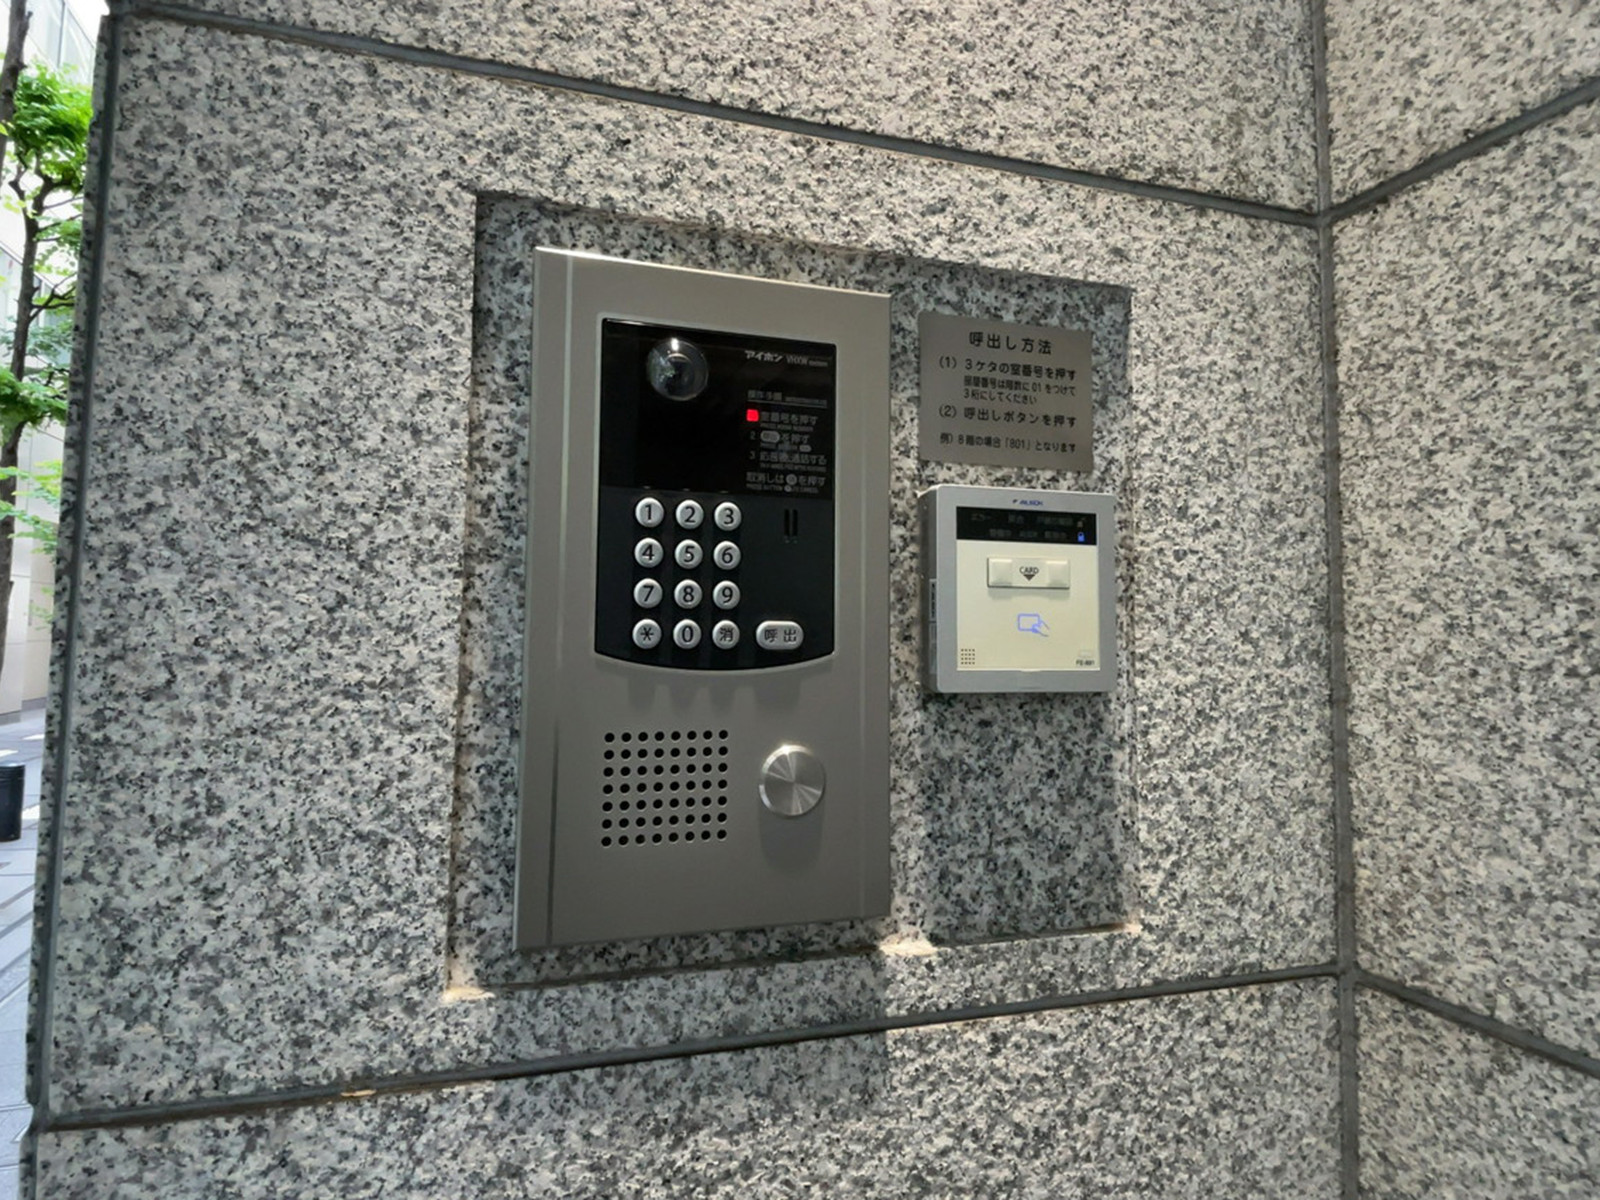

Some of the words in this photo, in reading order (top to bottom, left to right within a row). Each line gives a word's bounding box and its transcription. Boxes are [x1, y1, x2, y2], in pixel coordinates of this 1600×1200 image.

[969, 331, 1052, 355] 呼出し方法
[744, 350, 782, 362] アイホン
[939, 356, 957, 369] (1)
[965, 358, 1076, 381] 3ケタの室番号を押す
[939, 405, 957, 419] (2)
[964, 407, 1076, 428] 呼出しボタンを押す
[645, 504, 653, 521] 1
[684, 506, 695, 523] 2
[724, 508, 734, 525] 3
[642, 545, 655, 561] 4
[683, 545, 695, 562] 5
[722, 547, 733, 564] 6
[1019, 566, 1039, 575] CARD
[643, 585, 655, 602] 7
[683, 585, 694, 602] 8
[722, 587, 733, 603] 9
[681, 626, 693, 642] 0
[719, 627, 734, 642] 消
[764, 628, 797, 643] 呼出
